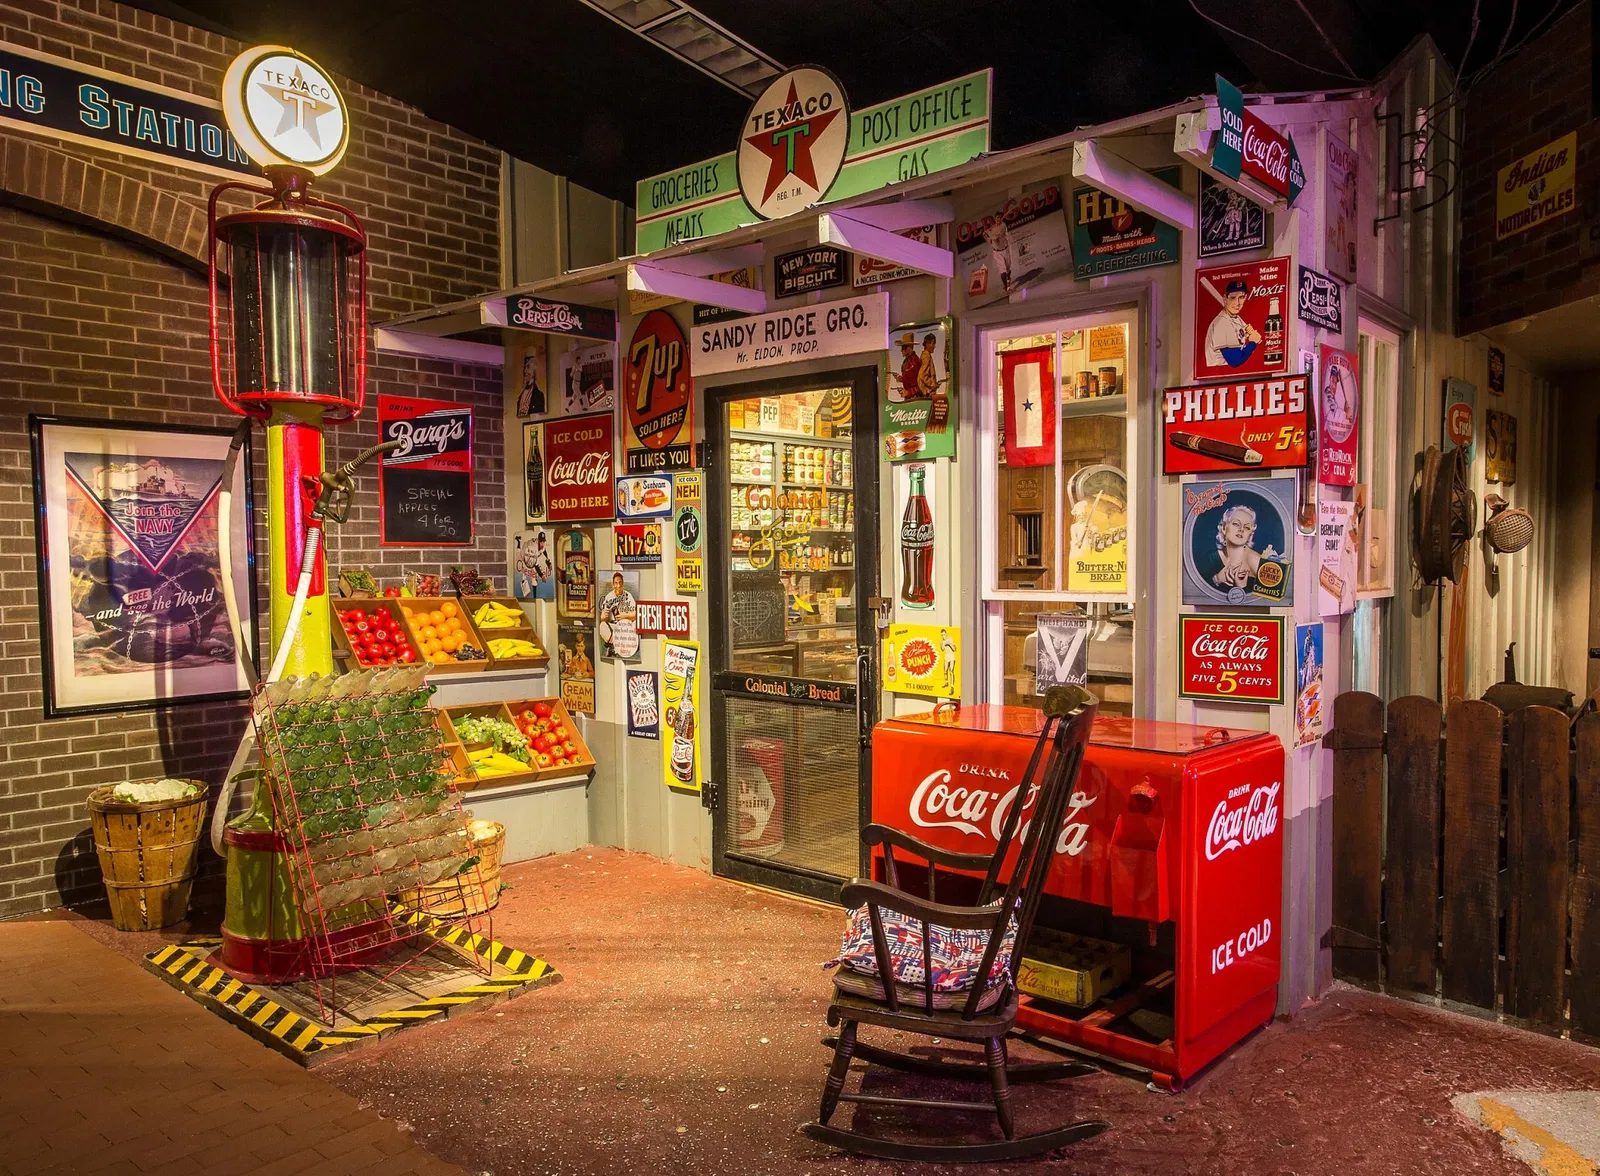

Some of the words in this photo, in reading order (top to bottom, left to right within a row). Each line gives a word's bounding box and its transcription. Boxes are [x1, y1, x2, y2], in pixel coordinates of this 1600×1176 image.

[263, 69, 330, 100] TEXACO
[282, 90, 317, 130] T
[751, 92, 832, 133] TEXACO
[862, 105, 900, 147] POST
[909, 83, 972, 133] OFFICE
[78, 83, 250, 165] STATION
[1222, 107, 1243, 133] SOLD
[772, 122, 810, 174] T
[1223, 127, 1243, 153] HERE
[1243, 124, 1288, 183] Coca-Cola
[899, 147, 929, 181] GAS
[1291, 158, 1301, 174] ICE
[1504, 147, 1568, 193] Indian
[651, 163, 719, 209] GROCERIES
[1289, 169, 1304, 188] COLD
[776, 191, 789, 201] REG.
[957, 217, 995, 242] OLD
[1003, 186, 1060, 219] GOLD
[1498, 188, 1573, 237] MOTORCYCLES
[664, 212, 704, 248] MEATS
[1102, 233, 1122, 243] Made
[1124, 228, 1143, 239] with
[782, 255, 804, 274] NEW
[807, 252, 838, 264] YORK
[1077, 263, 1092, 275] SO
[1096, 249, 1167, 272] REFRESHING
[1259, 266, 1278, 274] Make
[784, 269, 836, 290] BISCUIT
[855, 277, 861, 286] A
[861, 274, 877, 285] NICKEL
[1248, 283, 1285, 301] MOXIE
[699, 309, 710, 317] HIT
[1301, 310, 1311, 319] BEST
[702, 322, 756, 352] SANDY
[765, 313, 816, 342] RIDGE
[826, 304, 868, 332] GRO.
[790, 340, 819, 353] PROP.
[388, 403, 414, 412] DRINK
[1166, 379, 1306, 424] PHILLIES
[763, 406, 778, 420] PEP
[890, 409, 927, 422] Merita
[639, 420, 659, 438] SOLD
[660, 409, 684, 428] HERE
[1452, 410, 1472, 437] Crush
[388, 418, 464, 457] Barg's
[553, 433, 571, 444] ICE
[574, 429, 603, 442] COLD
[1248, 432, 1274, 443] ONLY
[1275, 426, 1305, 450] 5¢
[629, 455, 637, 468] IT
[640, 452, 666, 468] LIKES
[669, 450, 689, 465] YOU
[548, 451, 611, 487] Coca-Cola
[1333, 465, 1346, 477] COLA
[643, 480, 666, 489] Sunbeam
[676, 485, 699, 498] NEHI
[408, 488, 453, 500] SPECIAL
[745, 484, 828, 511] Colonial
[125, 503, 156, 516] Join
[159, 504, 181, 516] the
[551, 498, 578, 510] SOLD
[580, 496, 609, 508] HERE
[134, 519, 174, 533] NAVY
[418, 514, 428, 527] 4
[679, 515, 697, 541] 17¢
[438, 526, 456, 537] 20
[615, 532, 644, 555] RITZ
[678, 565, 700, 579] NEHI
[1260, 571, 1280, 581] STRIKE
[1262, 565, 1280, 574] LUCKY
[678, 581, 688, 589] Sold
[1253, 584, 1280, 597] CIGARETTES
[127, 590, 149, 603] FREE
[152, 594, 171, 611] the
[174, 588, 215, 607] World
[636, 604, 661, 630] FRESH
[665, 606, 688, 632] EGGS
[1039, 618, 1059, 627] THESE
[1062, 618, 1087, 627] HANDS
[1203, 624, 1222, 633] ICE
[1228, 625, 1259, 634] COLD
[1192, 634, 1270, 661] Coca-Cola
[907, 654, 931, 668] PUNCH
[1200, 661, 1213, 670] AS
[1219, 662, 1262, 672] ALWAYS
[1038, 674, 1053, 682] are
[1191, 674, 1216, 683] FIVE
[1216, 671, 1238, 694] 5
[1239, 677, 1272, 686] CENTS
[563, 682, 592, 697] CREAM
[746, 678, 787, 697] Colonial
[809, 684, 840, 701] Bread
[1037, 683, 1045, 691] to
[562, 697, 592, 711] WHEAT
[668, 709, 676, 724] 5¢
[959, 763, 1010, 780] DRINK
[1228, 783, 1251, 799] DRINK
[1205, 781, 1280, 861] Coca-Cola
[1211, 939, 1234, 975] ICE
[1237, 918, 1271, 958] COLD
[1050, 978, 1060, 987] IN
[1041, 985, 1070, 998] BOTTLES
